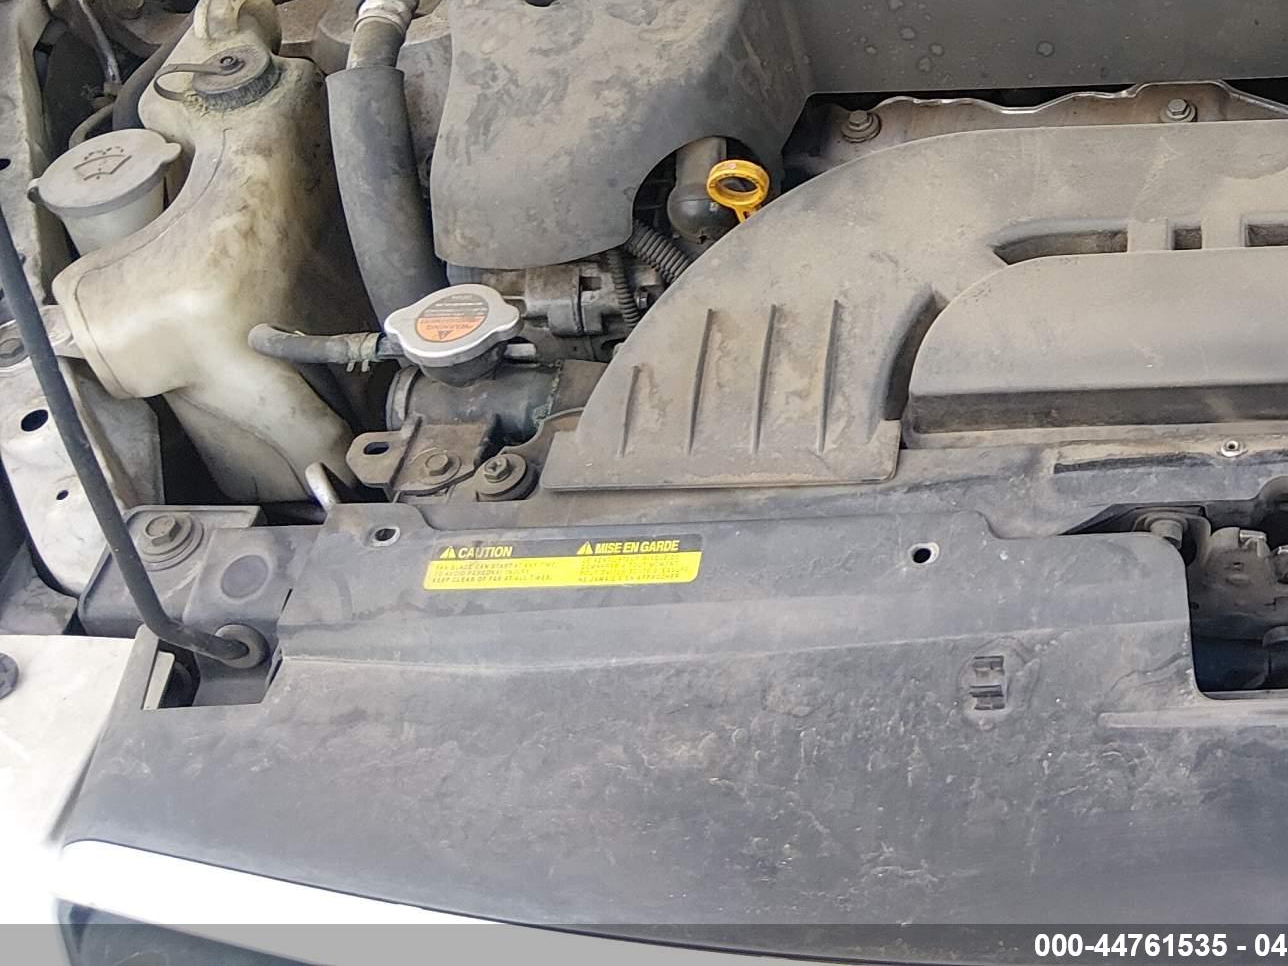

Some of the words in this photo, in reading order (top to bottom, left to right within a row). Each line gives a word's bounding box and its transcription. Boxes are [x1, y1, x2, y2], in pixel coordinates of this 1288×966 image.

[457, 545, 514, 559] CAUTION
[594, 542, 623, 554] MISE
[622, 541, 641, 553] EN
[639, 539, 681, 552] GARDE
